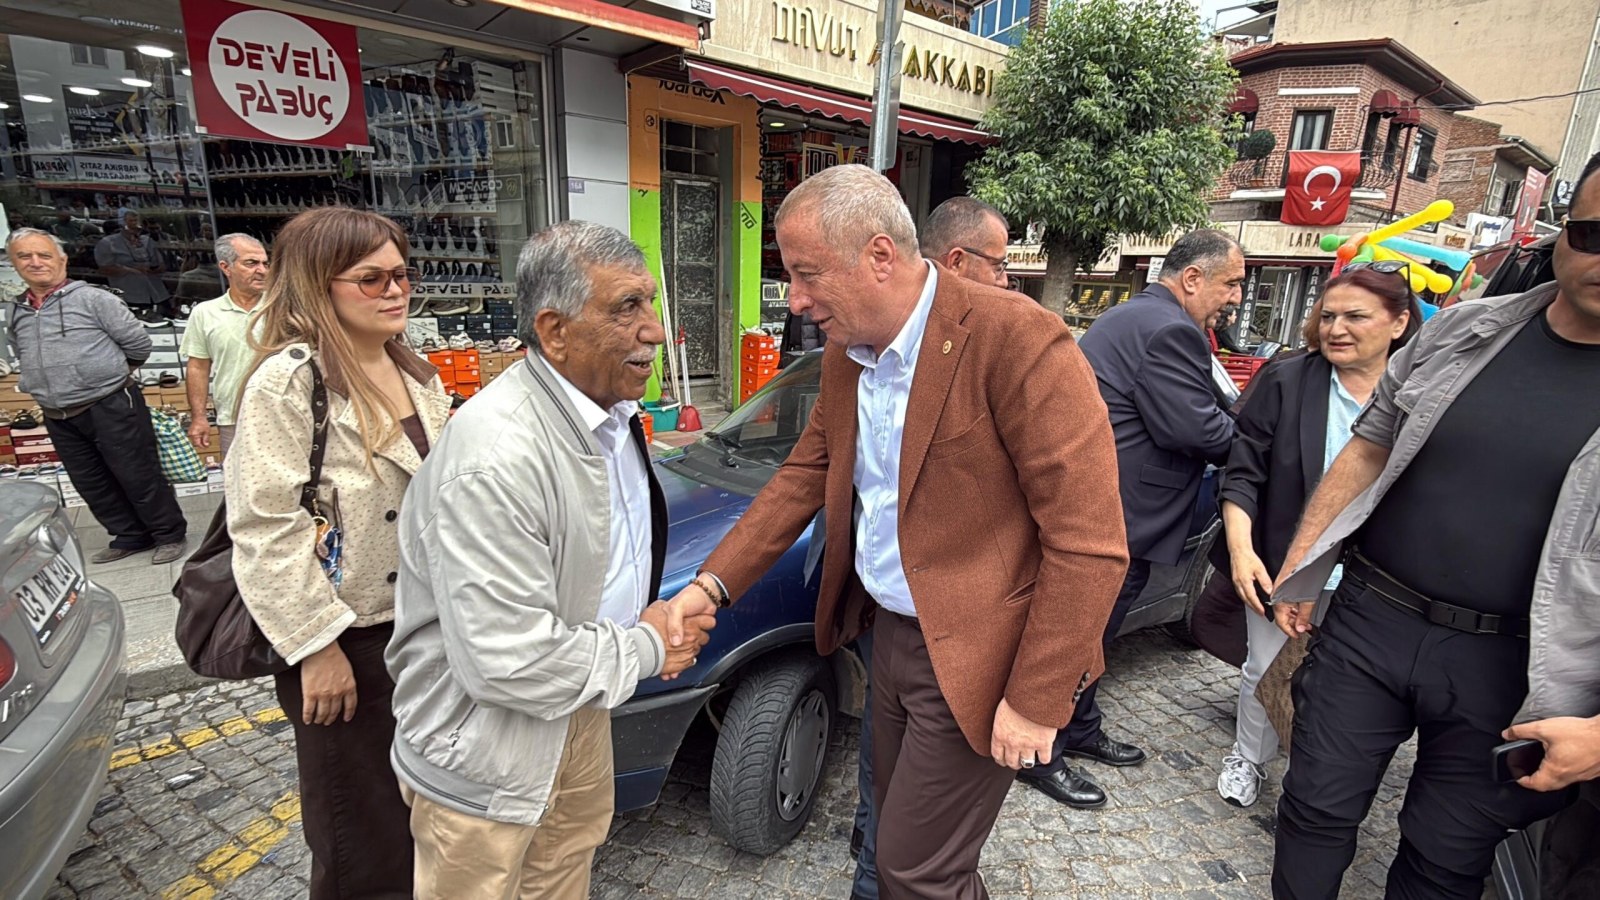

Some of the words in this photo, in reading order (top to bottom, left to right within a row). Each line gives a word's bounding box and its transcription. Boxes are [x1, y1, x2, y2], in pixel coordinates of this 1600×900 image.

[772, 1, 861, 61] DAVUT
[235, 79, 334, 125] PABUÇ
[1289, 232, 1320, 248] LARA
